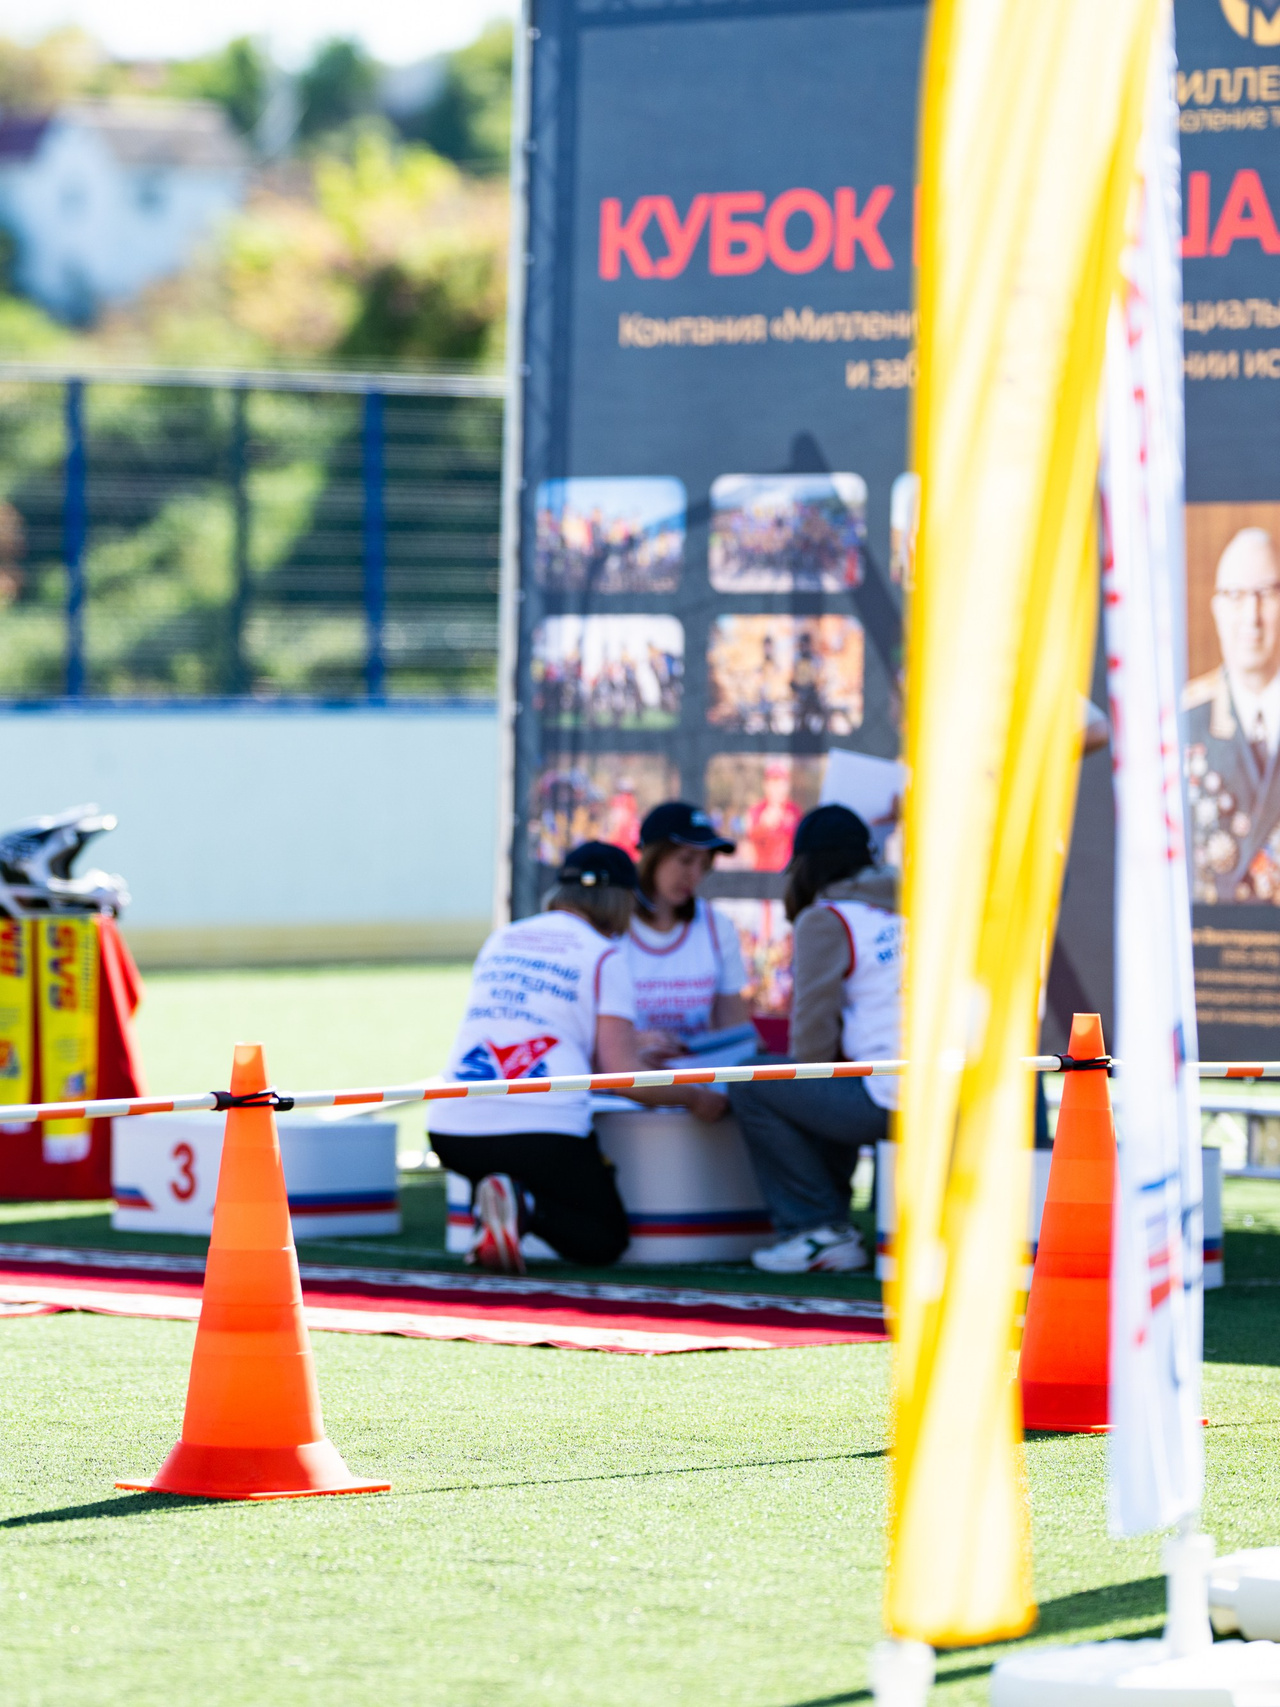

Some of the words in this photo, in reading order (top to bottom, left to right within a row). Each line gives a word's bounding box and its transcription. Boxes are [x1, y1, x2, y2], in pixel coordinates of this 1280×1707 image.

[598, 184, 895, 281] КУБОК
[619, 311, 768, 348] Компания
[844, 359, 870, 390] и
[170, 1142, 196, 1200] 3
